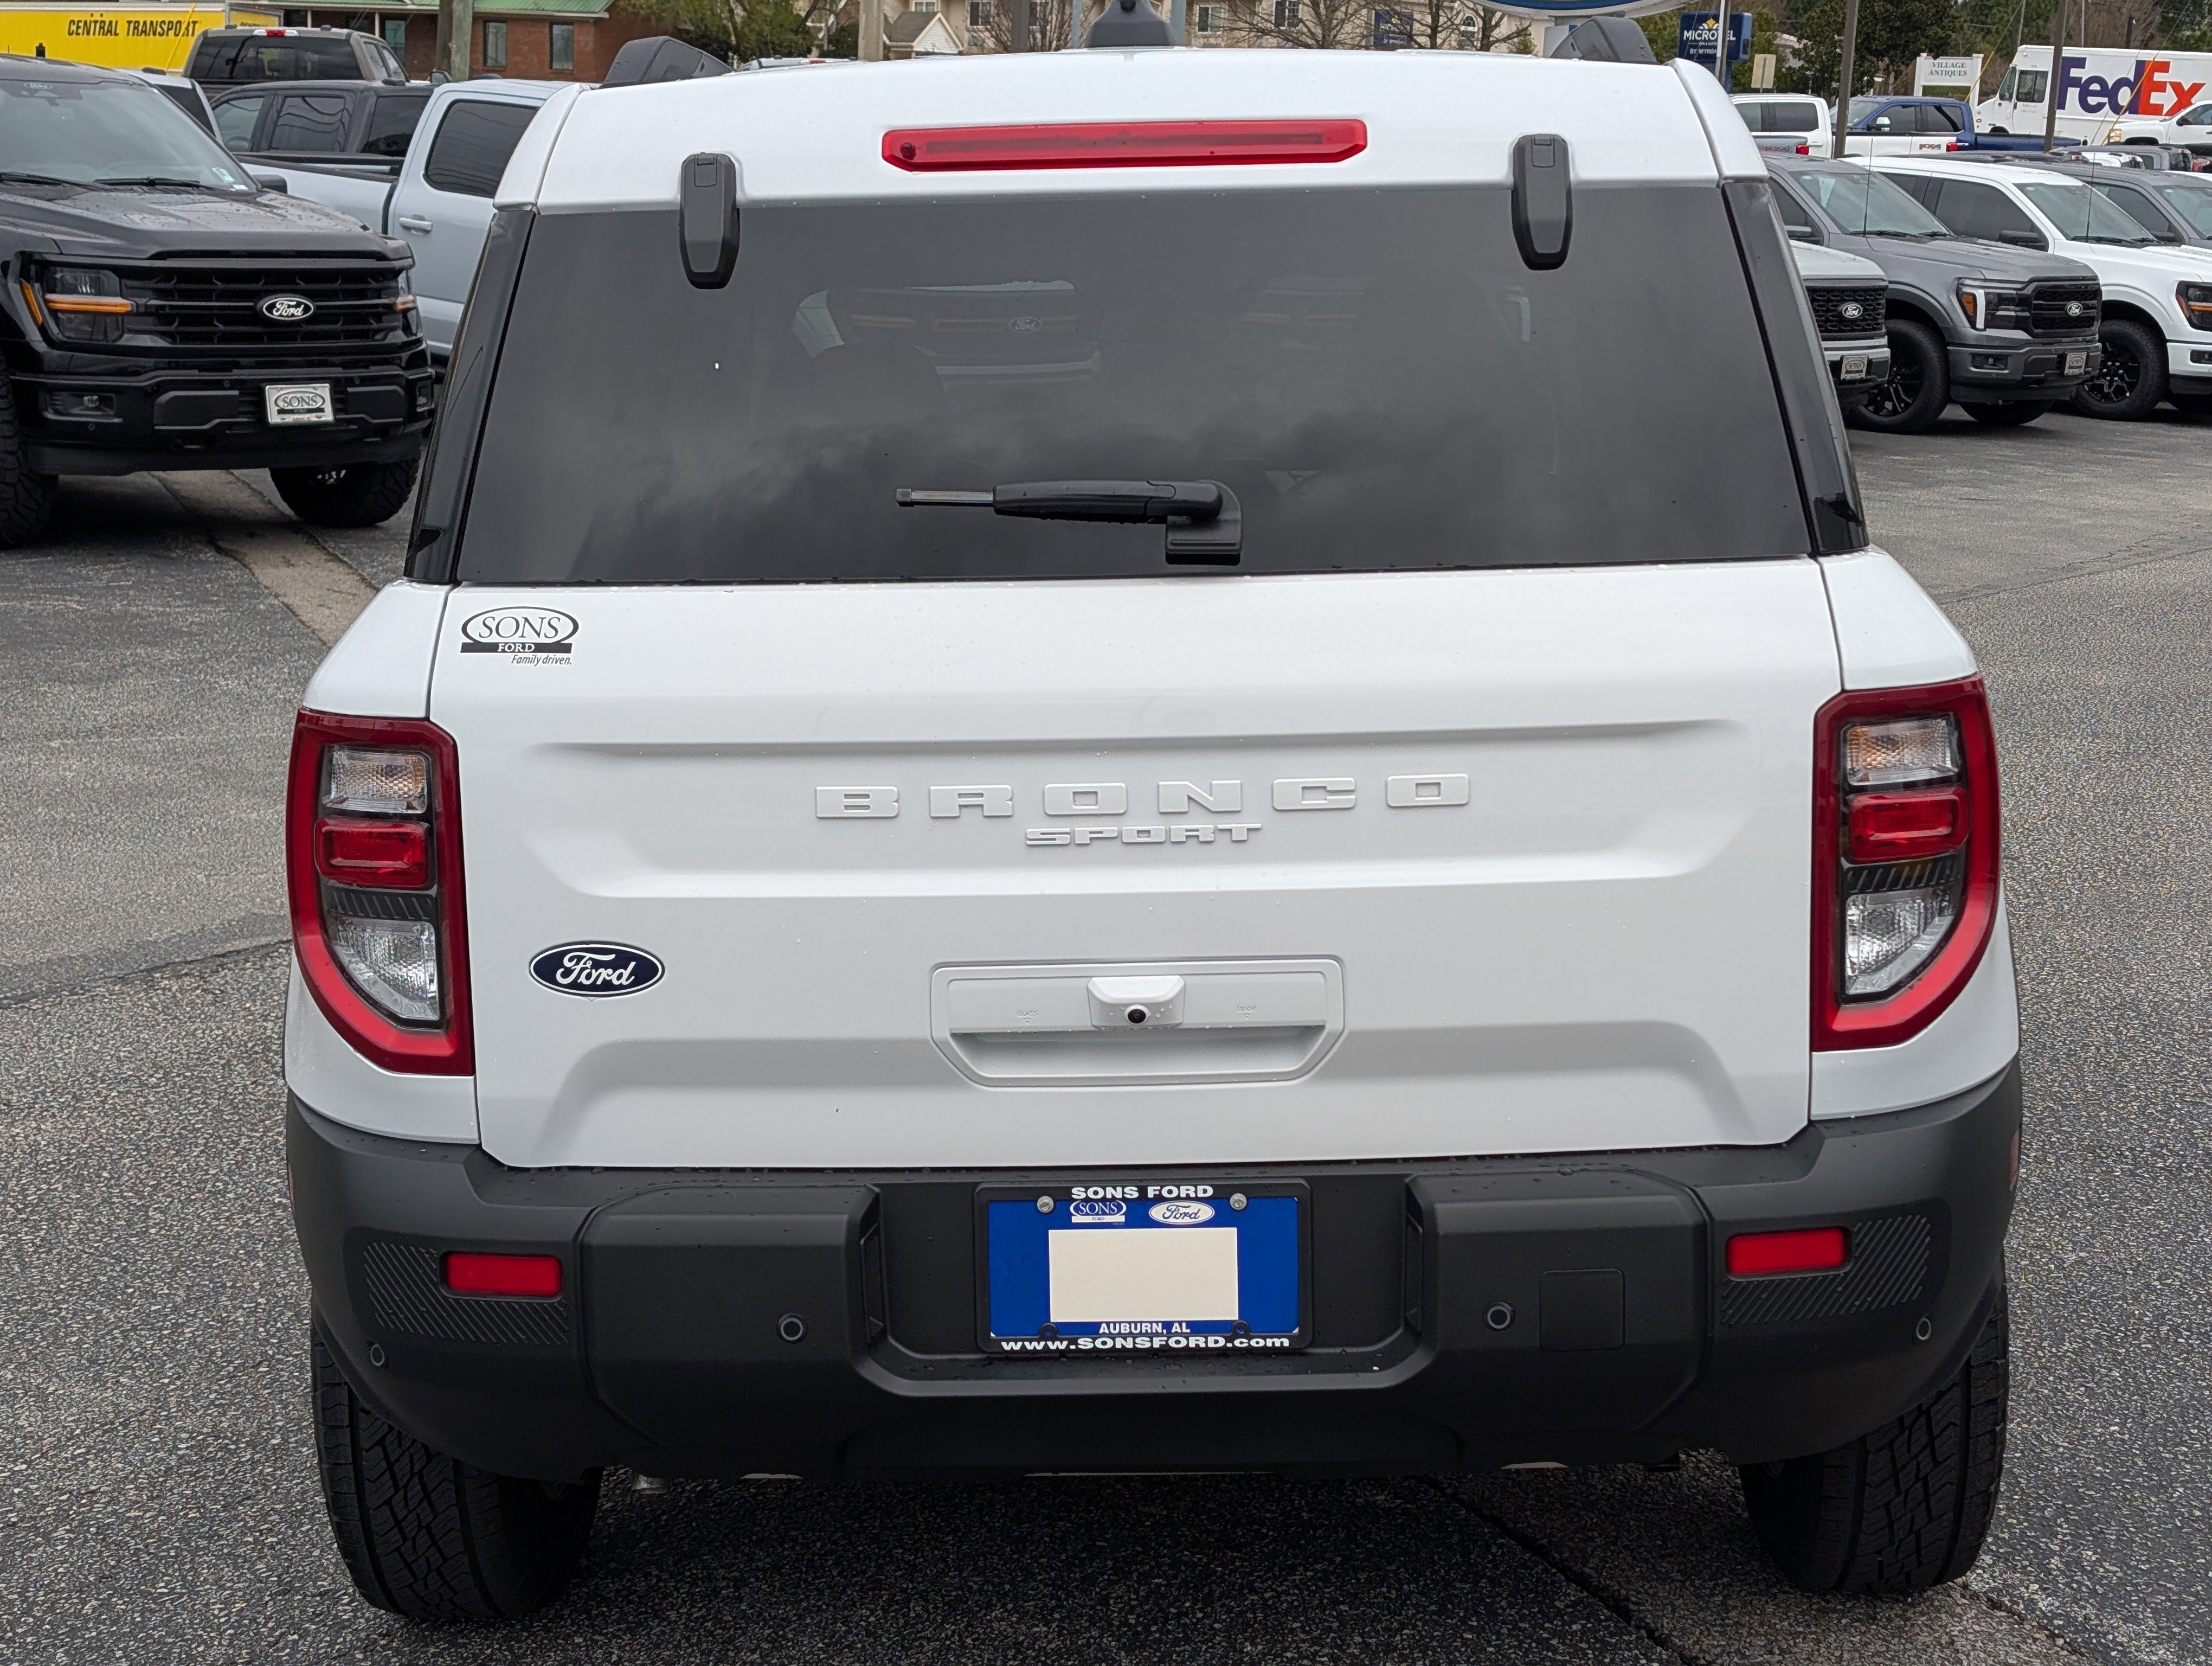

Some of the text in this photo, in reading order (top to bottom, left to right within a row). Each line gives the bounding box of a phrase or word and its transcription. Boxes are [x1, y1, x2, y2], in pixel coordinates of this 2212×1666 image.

[67, 19, 198, 37] CENTRAL TRANSPORT
[1683, 30, 1736, 40] MICROEL
[2056, 56, 2206, 116] FedEx
[273, 300, 304, 316] Ford
[282, 395, 317, 407] SONS
[479, 616, 561, 639] SONS
[497, 643, 535, 652] FORD
[511, 654, 571, 667] Family driven.
[815, 773, 1470, 818] BRONCO
[1025, 822, 1262, 847] SPORT
[556, 952, 636, 985] Ford
[1071, 1186, 1214, 1199] SONS FORD
[1079, 1201, 1118, 1215] SONS
[1162, 1204, 1201, 1220] Ford
[1099, 1322, 1191, 1335] AUBURN, AL
[1001, 1337, 1289, 1350] www.SONSFORD.com
